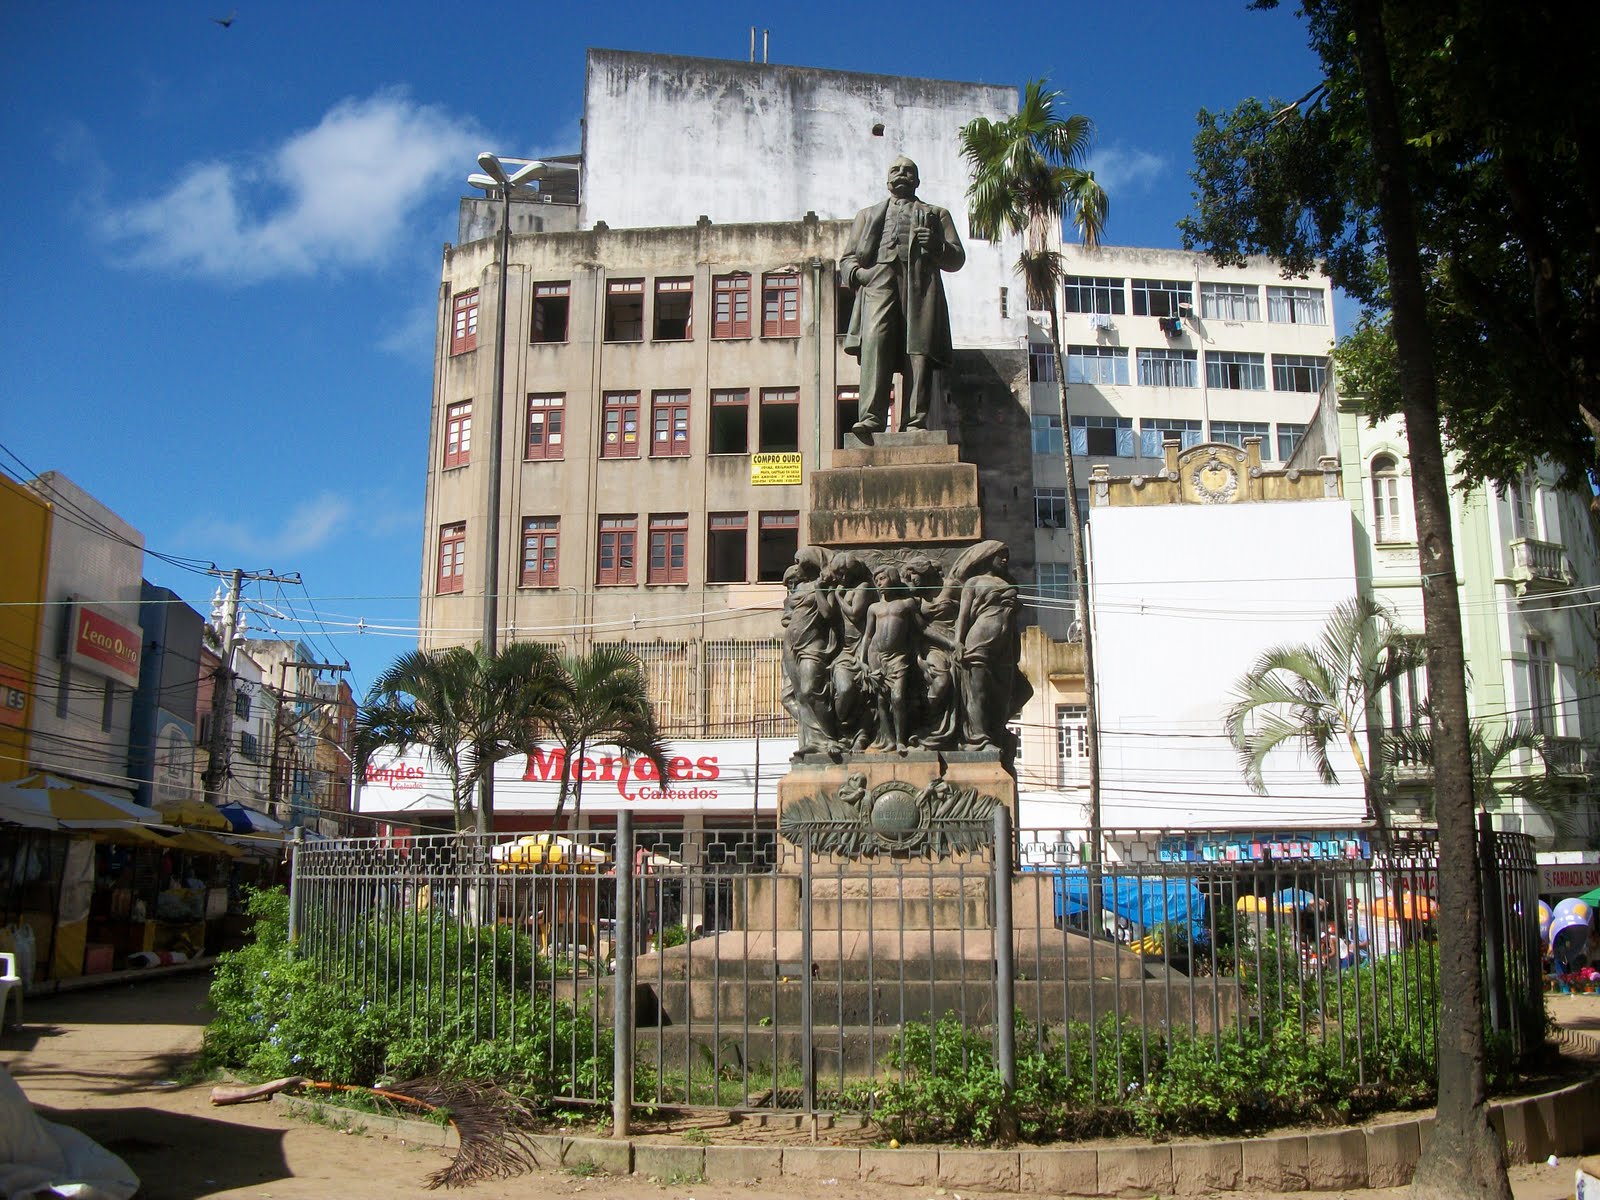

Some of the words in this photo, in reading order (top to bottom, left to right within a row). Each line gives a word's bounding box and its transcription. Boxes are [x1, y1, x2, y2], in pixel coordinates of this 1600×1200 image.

[753, 454, 780, 463] COMPRO
[782, 454, 801, 463] OURO
[82, 620, 112, 649] Leno
[115, 639, 137, 662] Ouro
